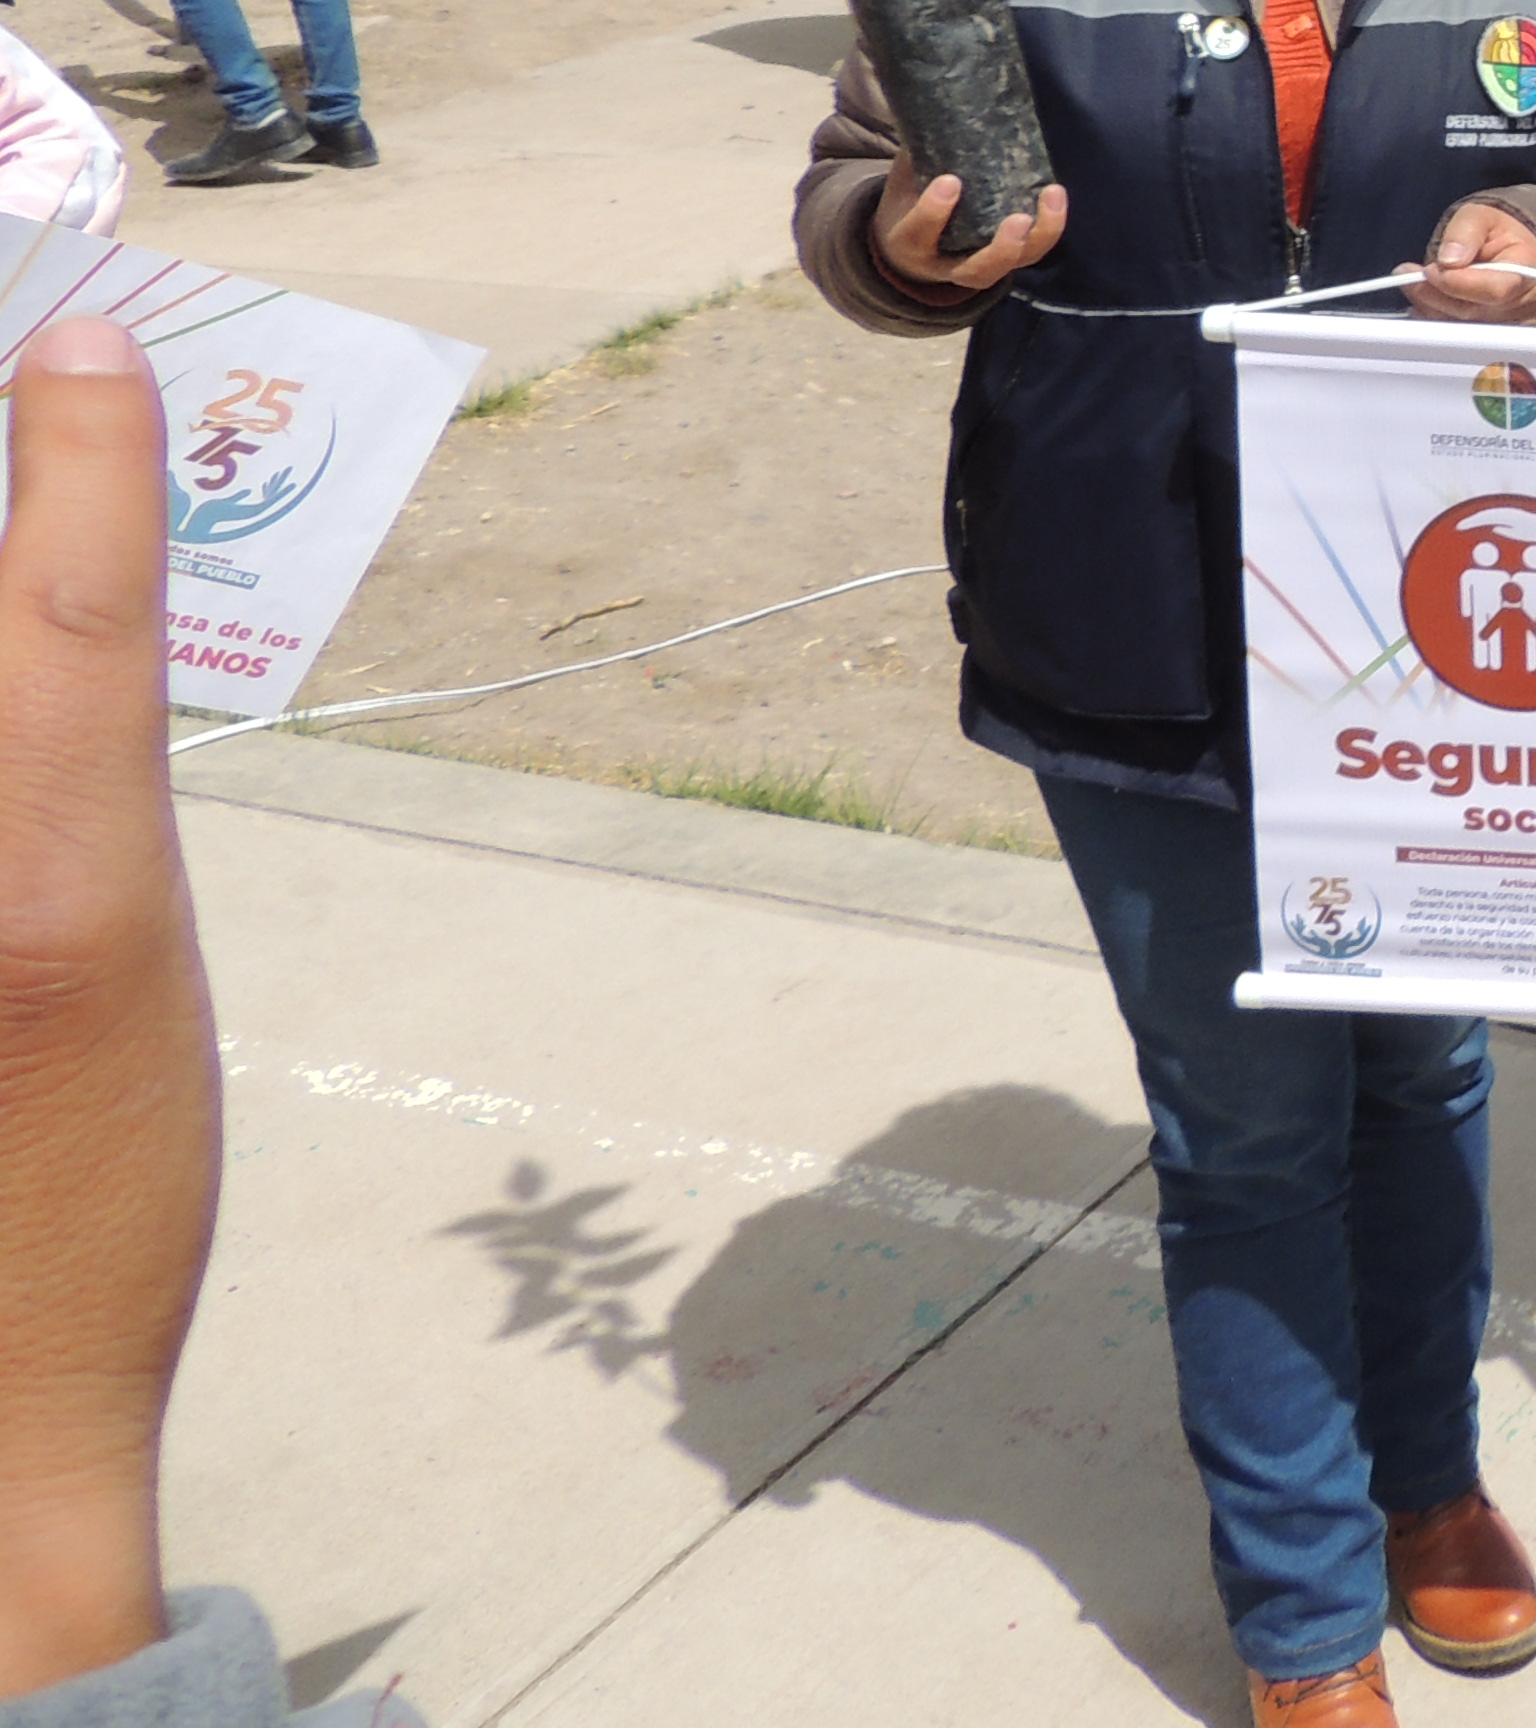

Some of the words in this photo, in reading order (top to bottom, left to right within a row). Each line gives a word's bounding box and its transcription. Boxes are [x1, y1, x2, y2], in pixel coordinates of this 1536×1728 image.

[203, 369, 304, 434] 25
[1430, 434, 1508, 449] DEFENSORÍA
[1511, 438, 1534, 451] DEL
[197, 563, 256, 586] PUEBLO
[166, 611, 210, 633] nsa
[217, 620, 254, 641] de
[258, 627, 303, 651] los
[167, 638, 273, 679] ANOS
[1408, 850, 1480, 864] Declaración
[1308, 876, 1353, 905] 25
